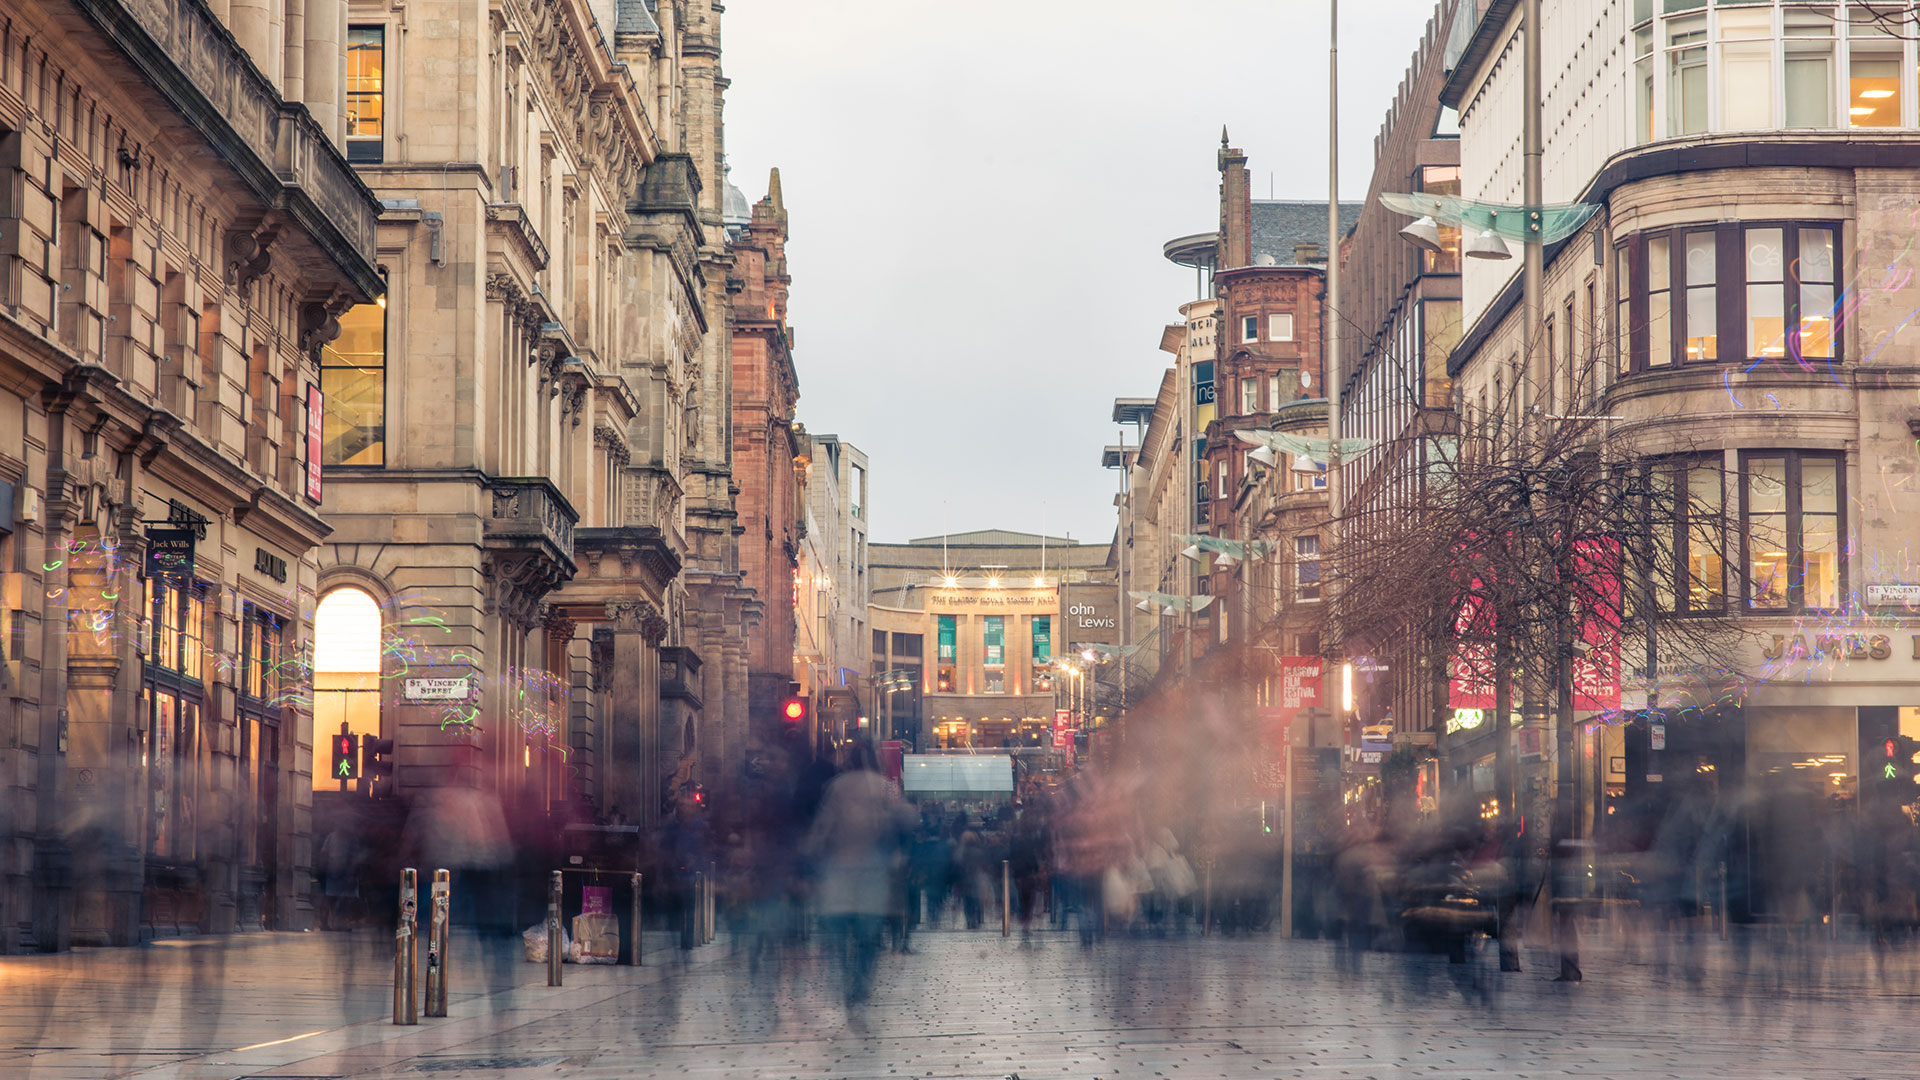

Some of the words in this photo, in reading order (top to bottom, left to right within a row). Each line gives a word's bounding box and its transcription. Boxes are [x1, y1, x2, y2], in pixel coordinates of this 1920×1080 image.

[152, 540, 168, 549] Jack
[170, 540, 190, 549] Wills
[1068, 603, 1095, 615] ohn
[1079, 615, 1115, 628] Lewis
[1764, 634, 1892, 661] JAMES
[1283, 666, 1319, 676] GLASGOW
[1283, 677, 1301, 687] FILM
[1283, 687, 1316, 698] FESTIVAL
[1283, 698, 1300, 708] 2019
